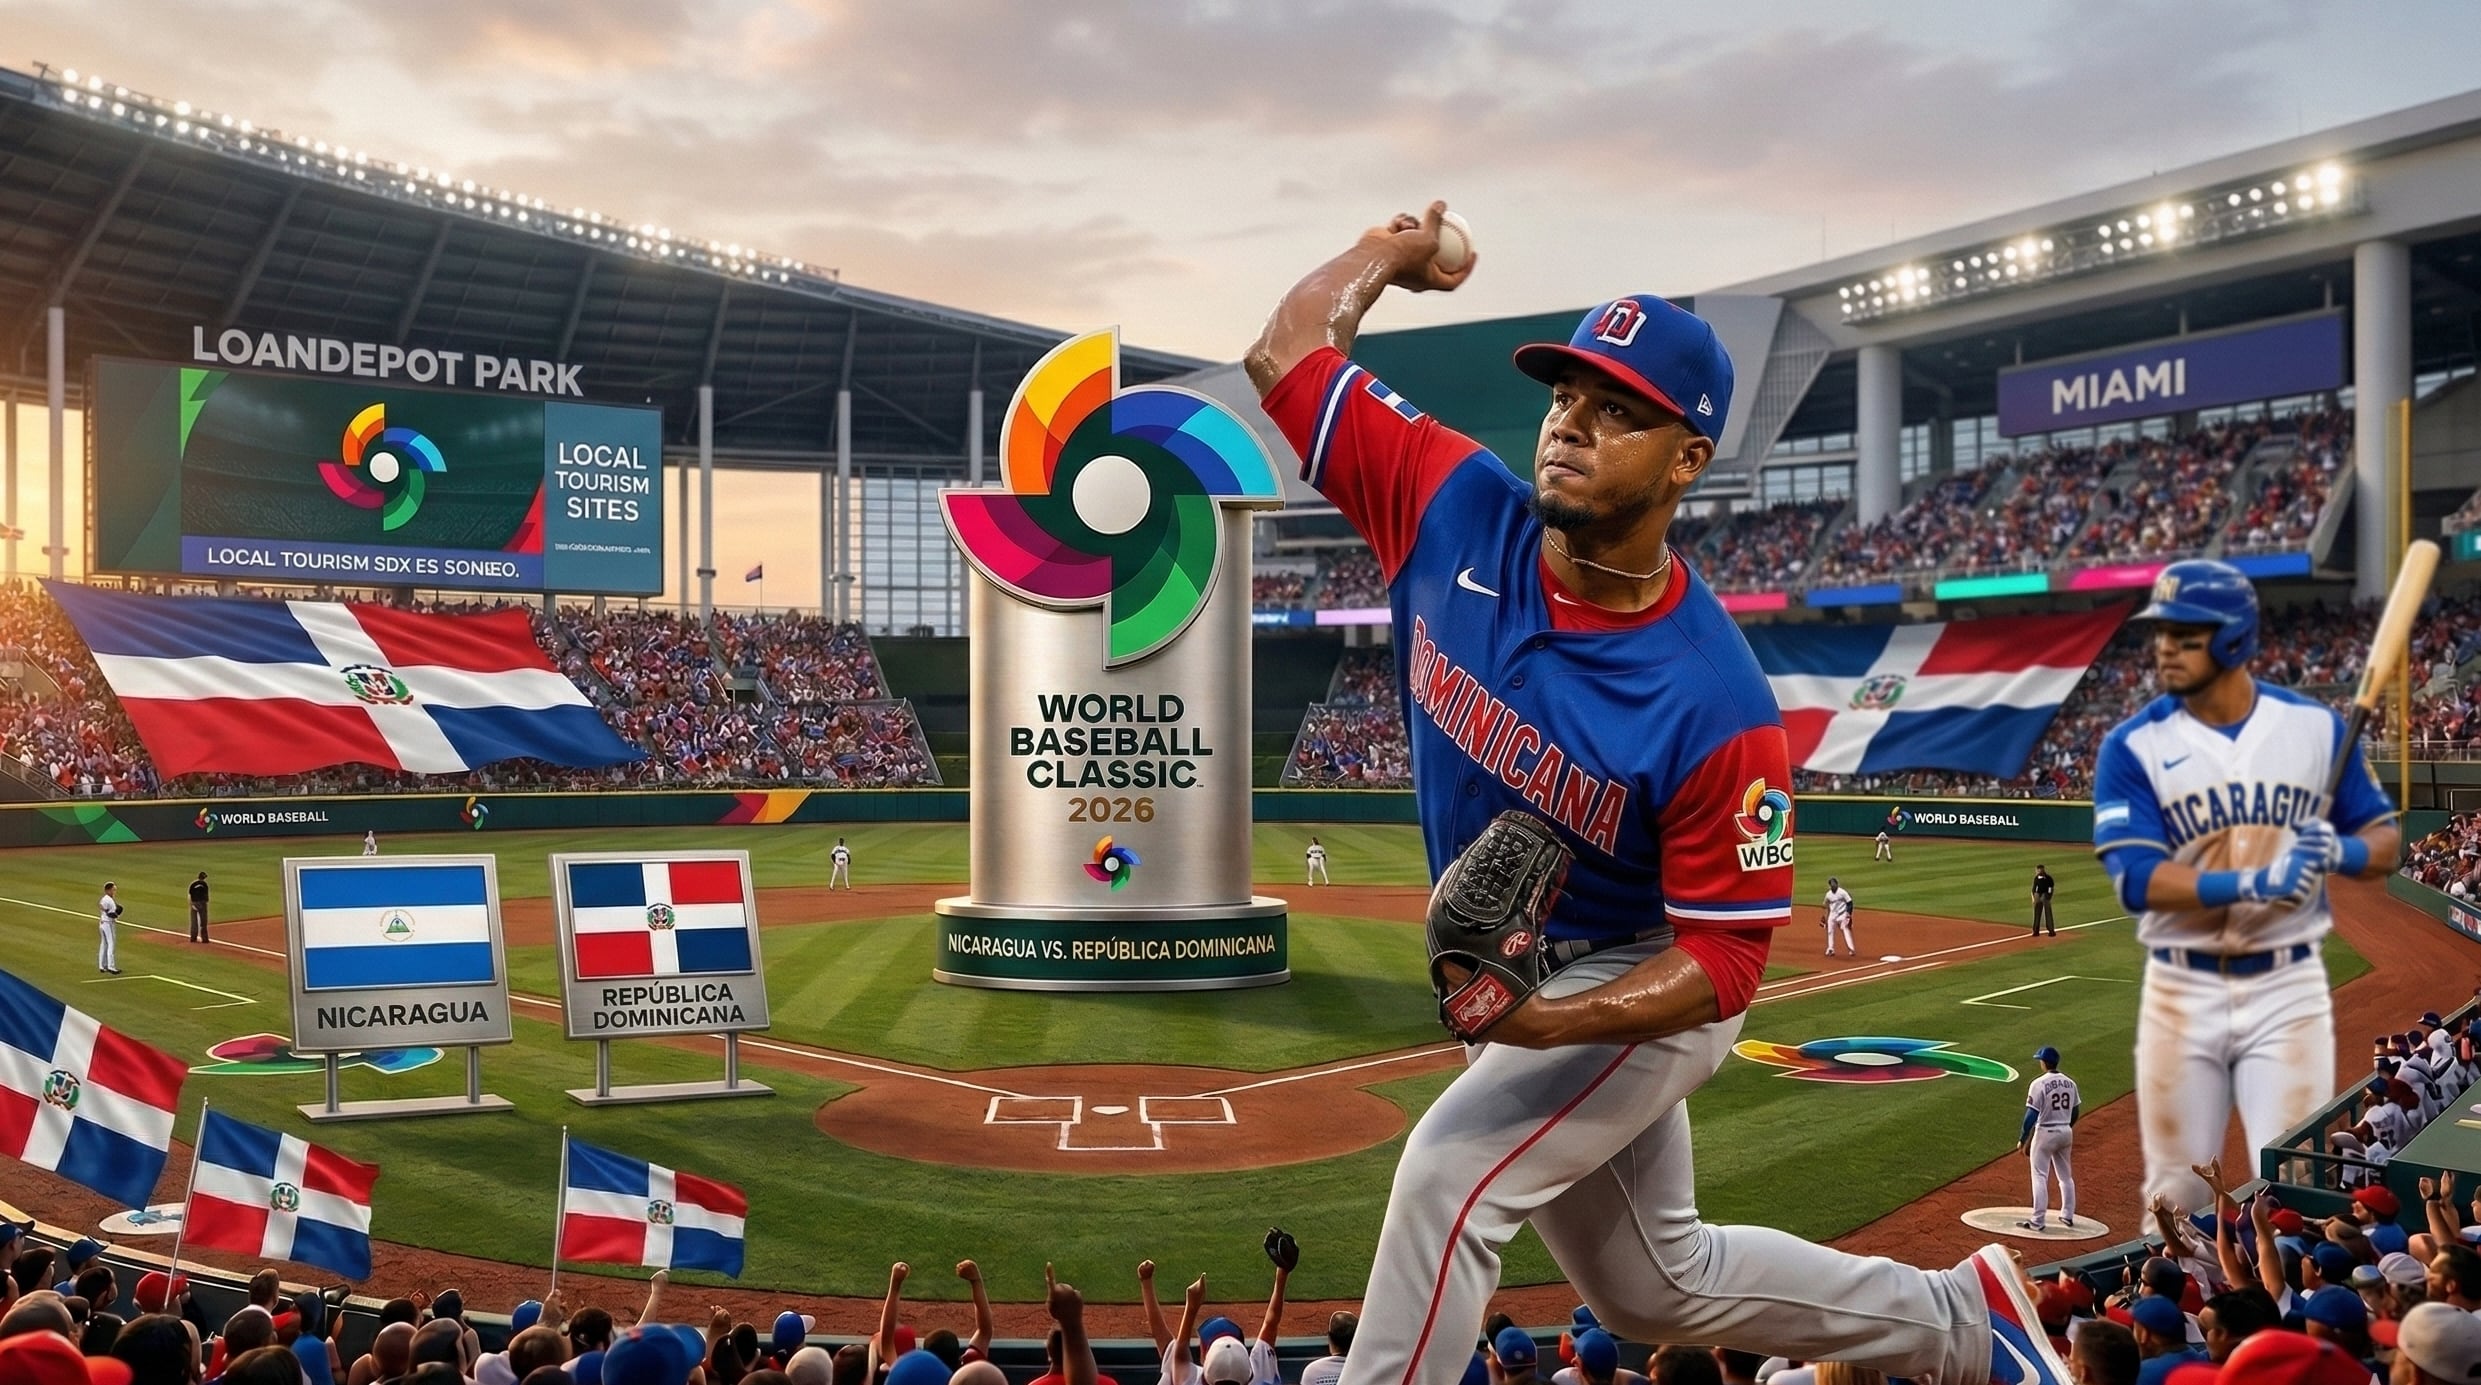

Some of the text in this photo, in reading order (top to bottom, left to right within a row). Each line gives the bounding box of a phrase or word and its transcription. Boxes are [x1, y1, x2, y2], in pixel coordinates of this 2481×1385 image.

[193, 326, 583, 397] LOANDEPOT PARK
[2053, 358, 2186, 414] MIAMI
[559, 442, 647, 470] LOCAL
[555, 470, 649, 495] TOURISM
[567, 496, 639, 521] SITES
[208, 548, 276, 567] LOCAL
[280, 551, 369, 571] TOURISM
[374, 557, 411, 573] SDX
[416, 558, 439, 574] ES
[1037, 693, 1185, 724] WORLD
[1010, 727, 1214, 756] BASEBALL
[1409, 614, 1628, 857] DOMINICANA
[1026, 759, 1198, 789] CLASSIC
[221, 811, 329, 825] WORLD BASEBALL
[1068, 796, 1155, 823] 2026
[1914, 813, 2020, 826] WORLD BASEBALL
[1741, 843, 1793, 867] WBC
[948, 933, 1276, 961] NICARAGUA VS. REPÚBLICA DOMINICANA
[602, 981, 734, 1007] REPÚBLICA
[318, 1001, 489, 1029] NICARAGUA
[593, 1005, 745, 1030] DOMINICANA
